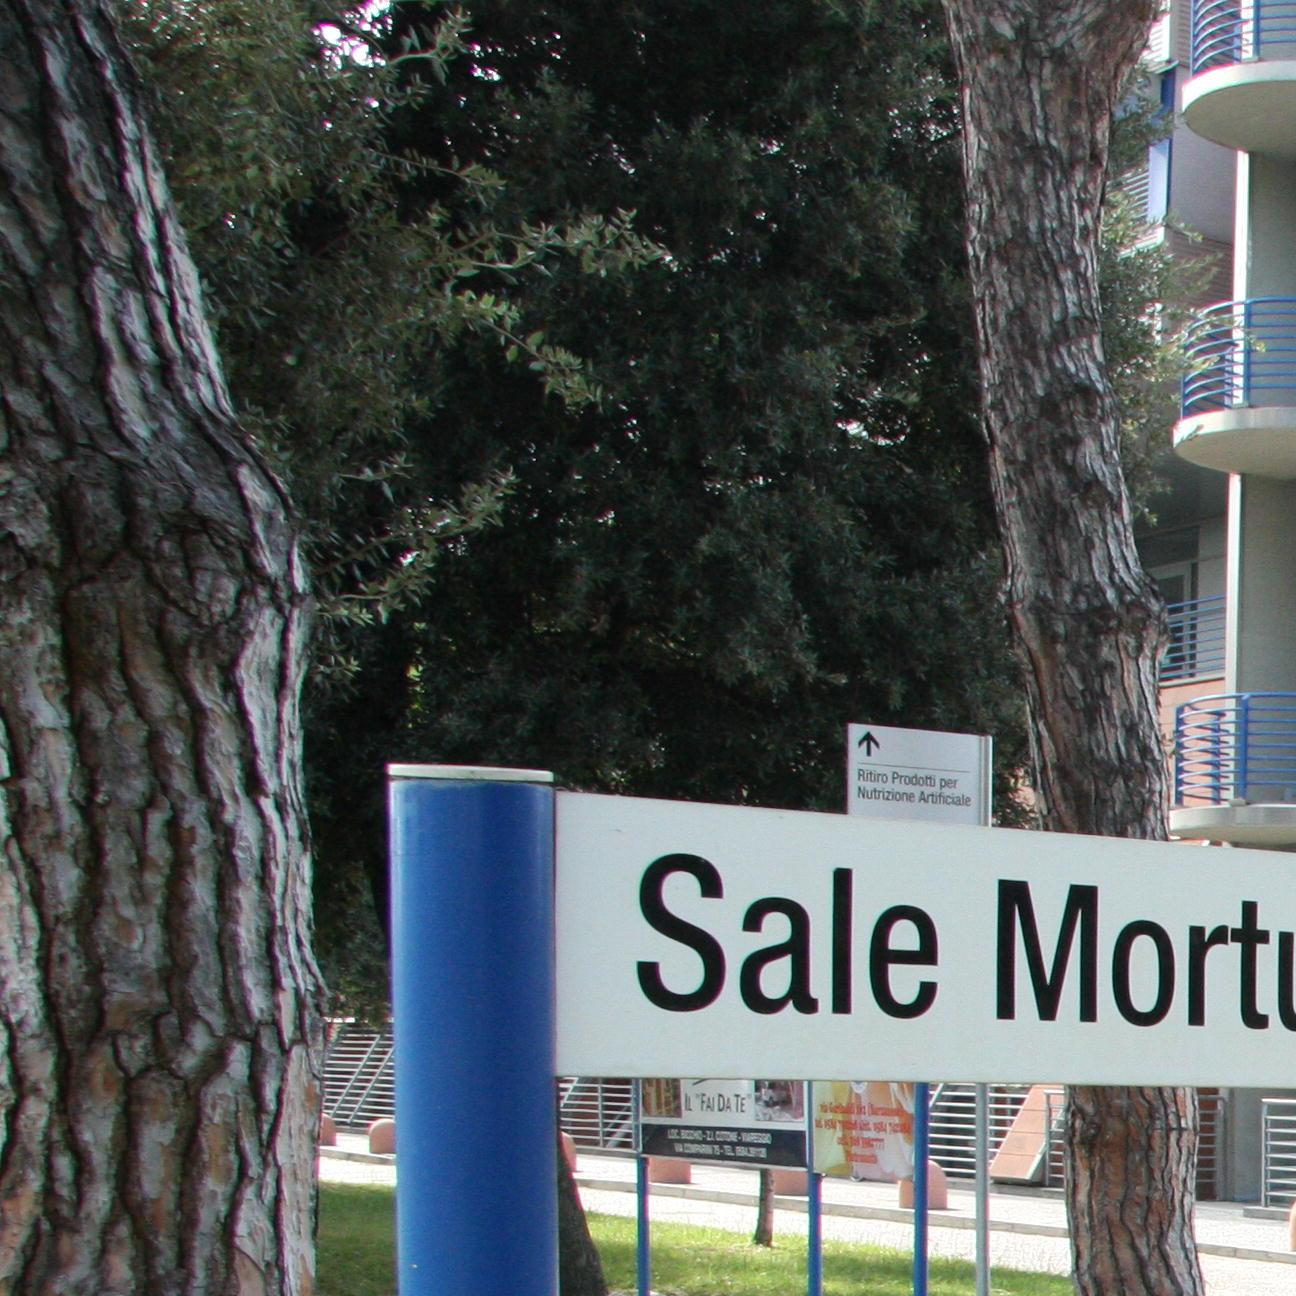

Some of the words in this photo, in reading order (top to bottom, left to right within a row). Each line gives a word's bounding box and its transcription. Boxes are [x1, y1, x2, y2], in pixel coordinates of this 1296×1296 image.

[857, 769, 888, 784] Ritiro
[892, 772, 936, 787] Prodotti
[940, 777, 959, 792] per
[857, 787, 915, 804] Nutrizione
[918, 790, 972, 807] Artificiale
[635, 852, 939, 1020] Sale
